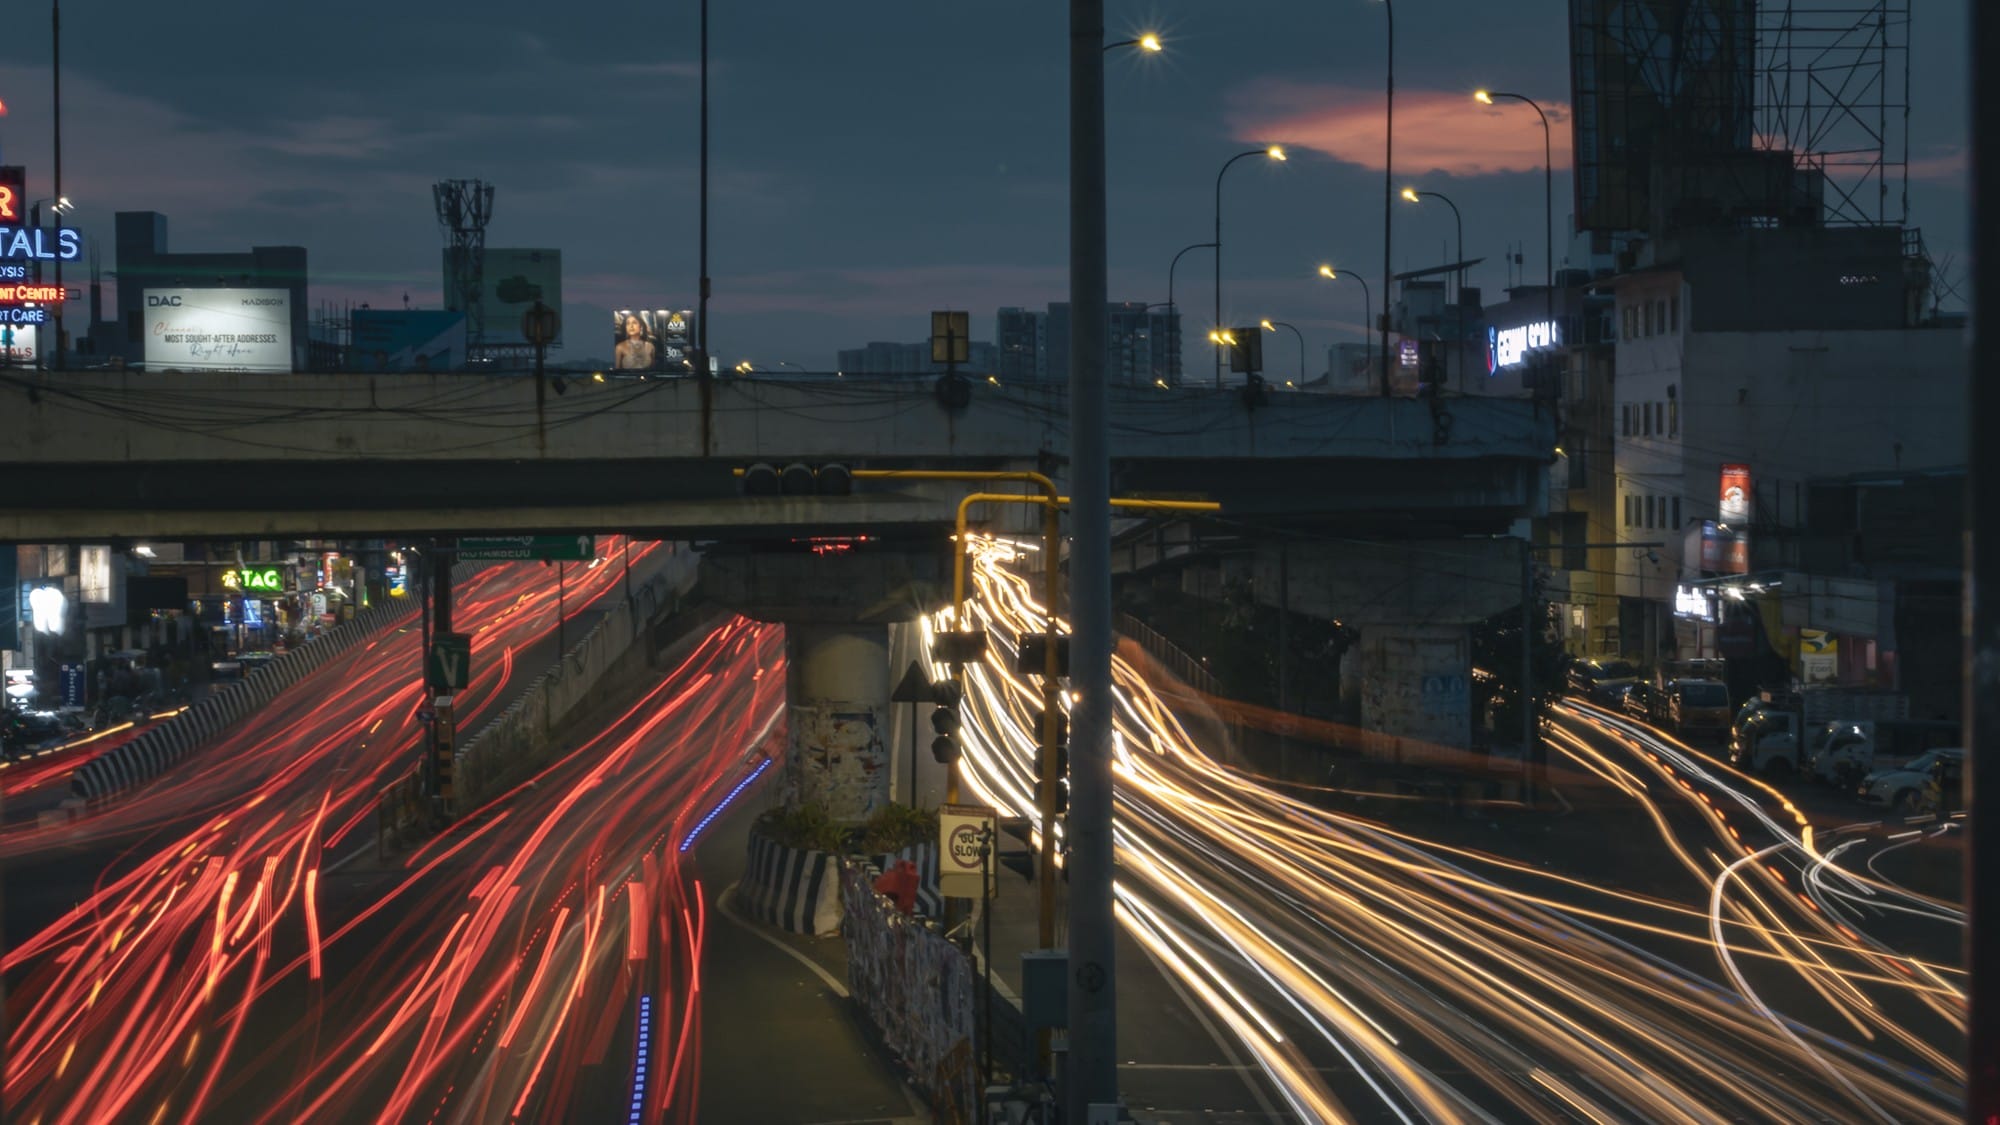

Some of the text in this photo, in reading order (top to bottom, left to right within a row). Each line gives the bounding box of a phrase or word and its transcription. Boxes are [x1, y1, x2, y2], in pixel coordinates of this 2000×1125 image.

[148, 296, 182, 307] DAC
[241, 298, 283, 307] MADISON
[11, 308, 43, 322] CARE
[164, 334, 184, 343] MOST
[185, 334, 235, 343] SOUGHT-AFTER
[241, 570, 277, 587] TAG
